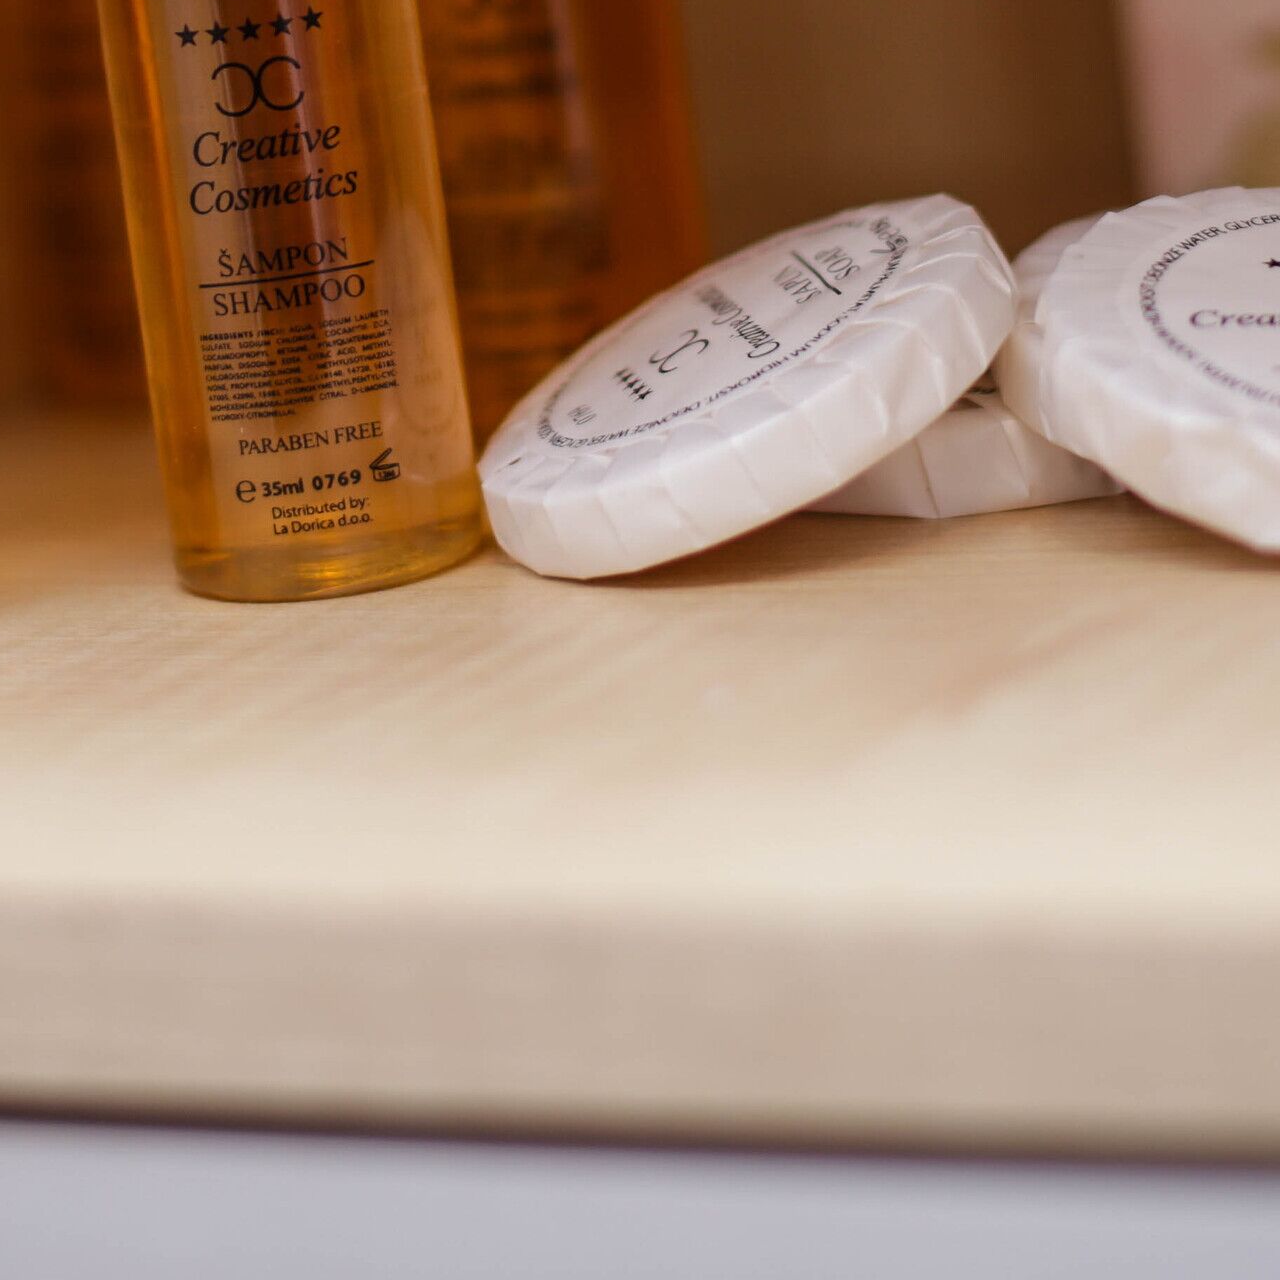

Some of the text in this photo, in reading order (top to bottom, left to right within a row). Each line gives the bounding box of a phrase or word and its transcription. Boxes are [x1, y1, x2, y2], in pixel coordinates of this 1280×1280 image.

[193, 122, 341, 167] Creative
[190, 169, 358, 215] Cosmetics
[218, 237, 348, 277] ŠAMPON
[213, 274, 366, 316] SHAMPOO
[729, 314, 780, 359] Creative
[239, 421, 384, 455] PARABEN FREE
[261, 478, 305, 497] 35ml
[312, 469, 361, 490] 0769
[272, 498, 346, 519] Distributed
[273, 523, 288, 535] La
[291, 518, 335, 534] Dorica
